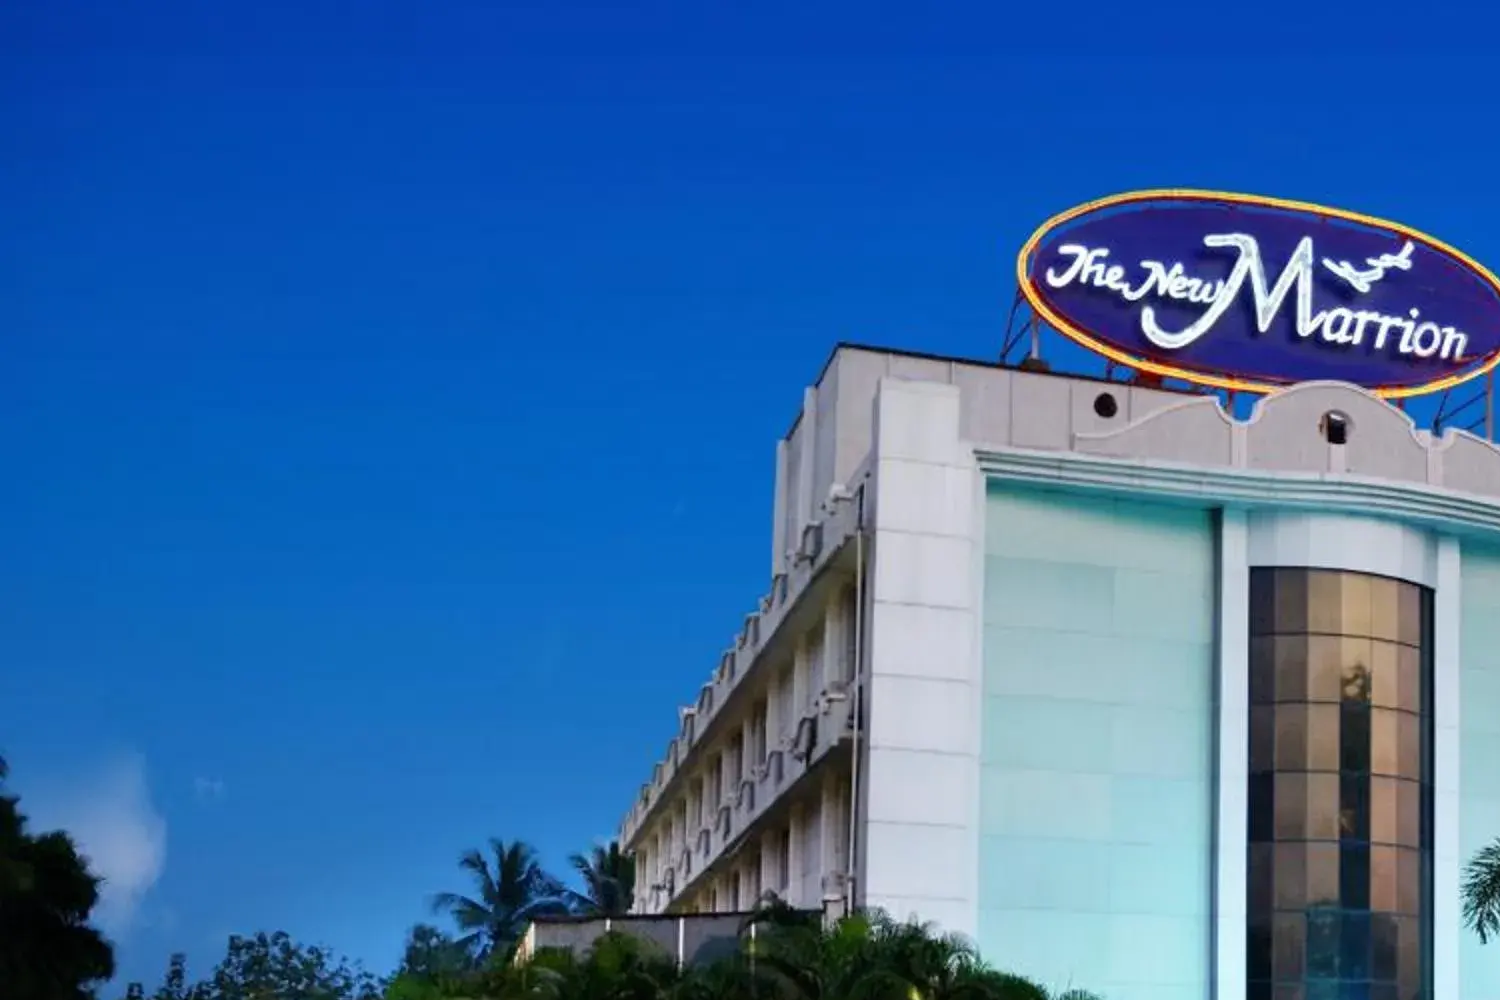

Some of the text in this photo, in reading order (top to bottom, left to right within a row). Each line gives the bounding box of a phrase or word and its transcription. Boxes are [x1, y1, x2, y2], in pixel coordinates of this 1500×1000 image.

[1046, 232, 1468, 360] The New Marrion
